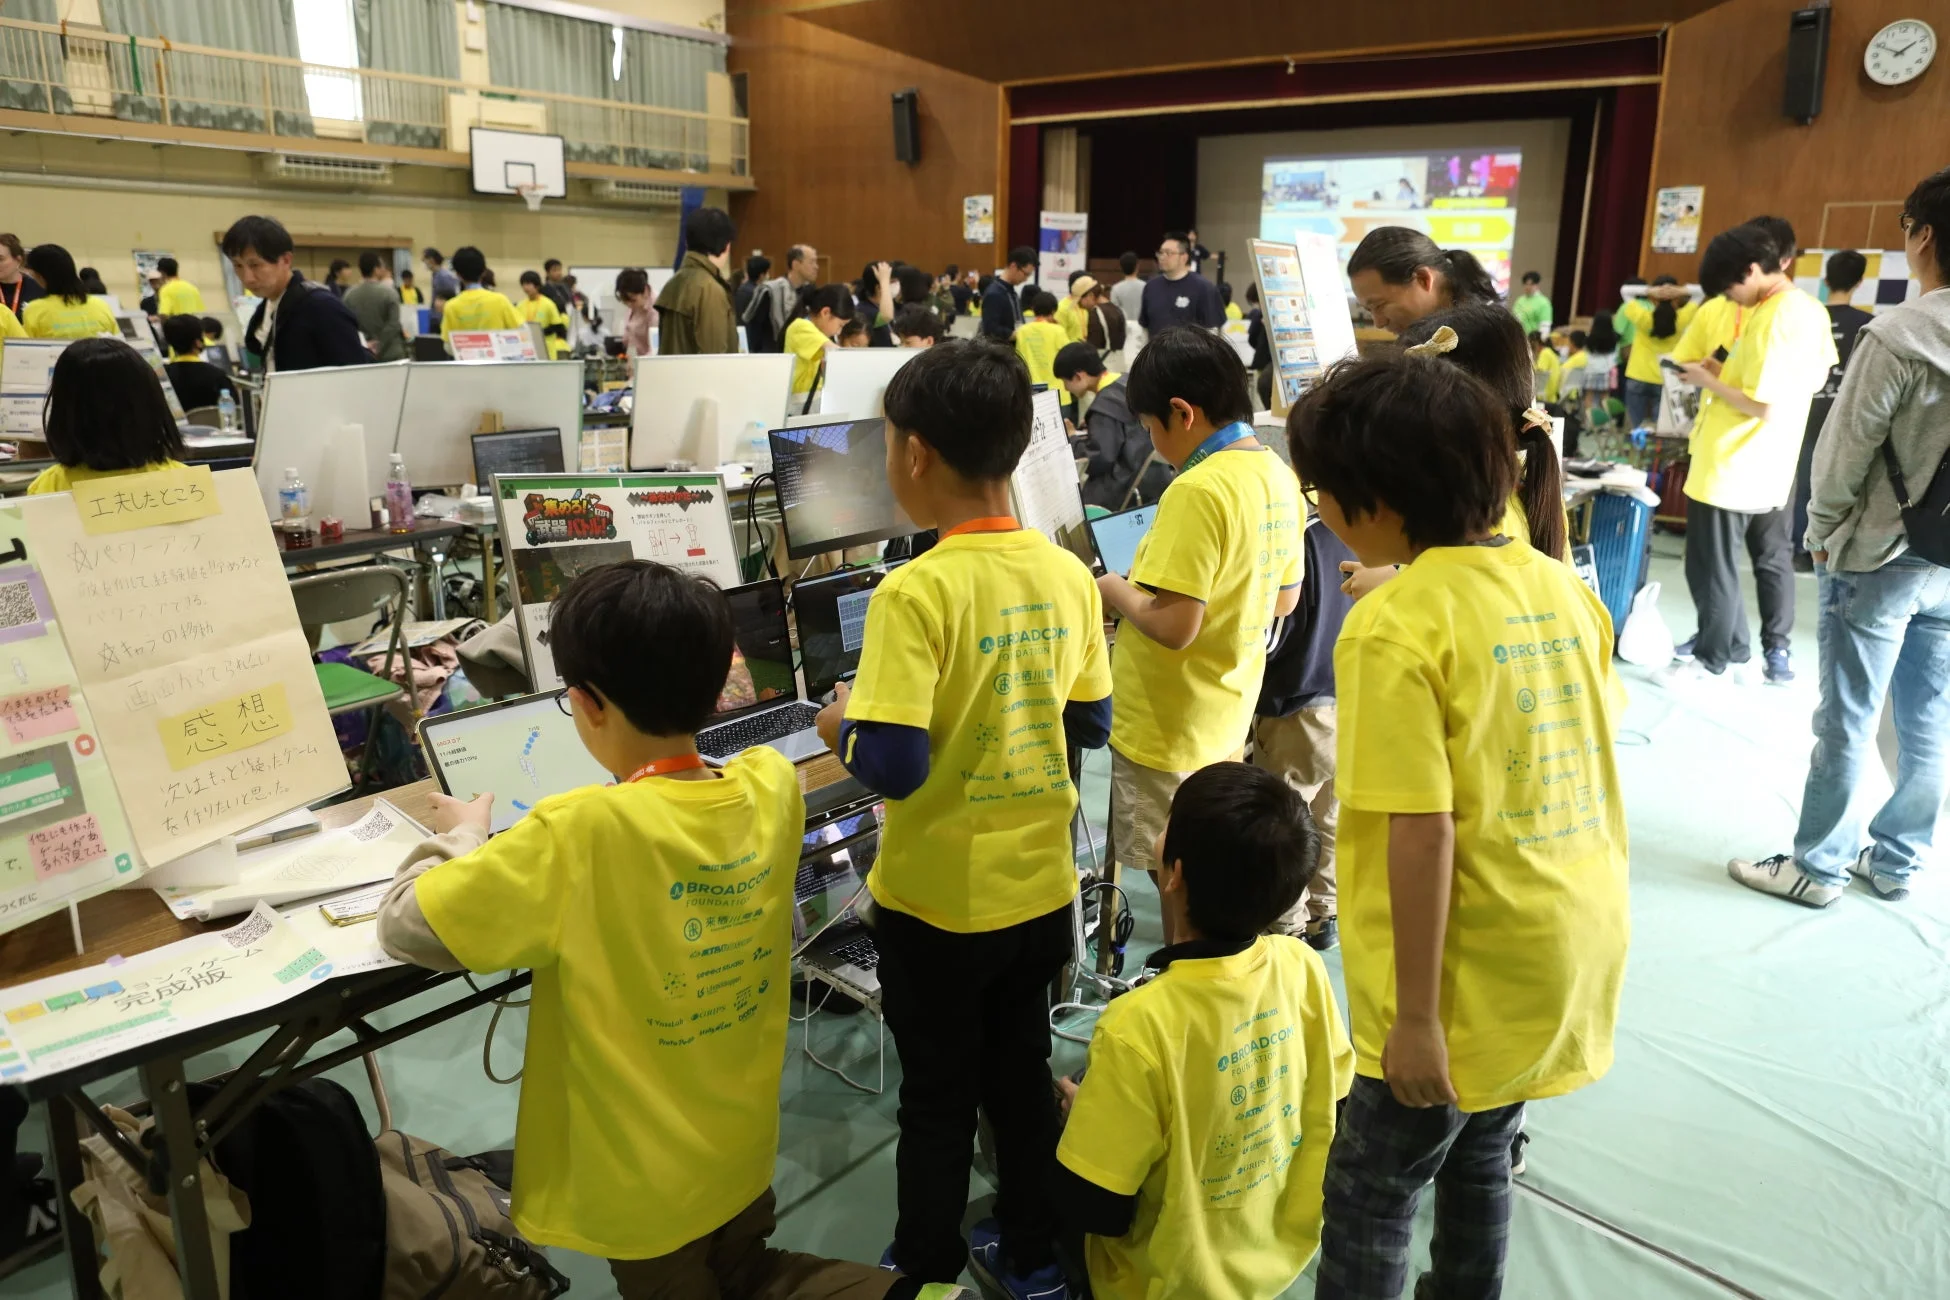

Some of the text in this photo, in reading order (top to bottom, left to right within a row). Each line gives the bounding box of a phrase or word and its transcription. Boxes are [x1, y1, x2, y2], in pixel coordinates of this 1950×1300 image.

[90, 484, 205, 518] 工夫したところ
[997, 646, 1050, 662] FODATION
[1013, 669, 1054, 682] 来栖川電
[1027, 721, 1053, 732] studio
[28, 816, 96, 845] 他にも作った
[686, 866, 772, 896] BROADCOM
[114, 966, 233, 1012] 完成版
[1230, 1024, 1294, 1065] BROADCOM
